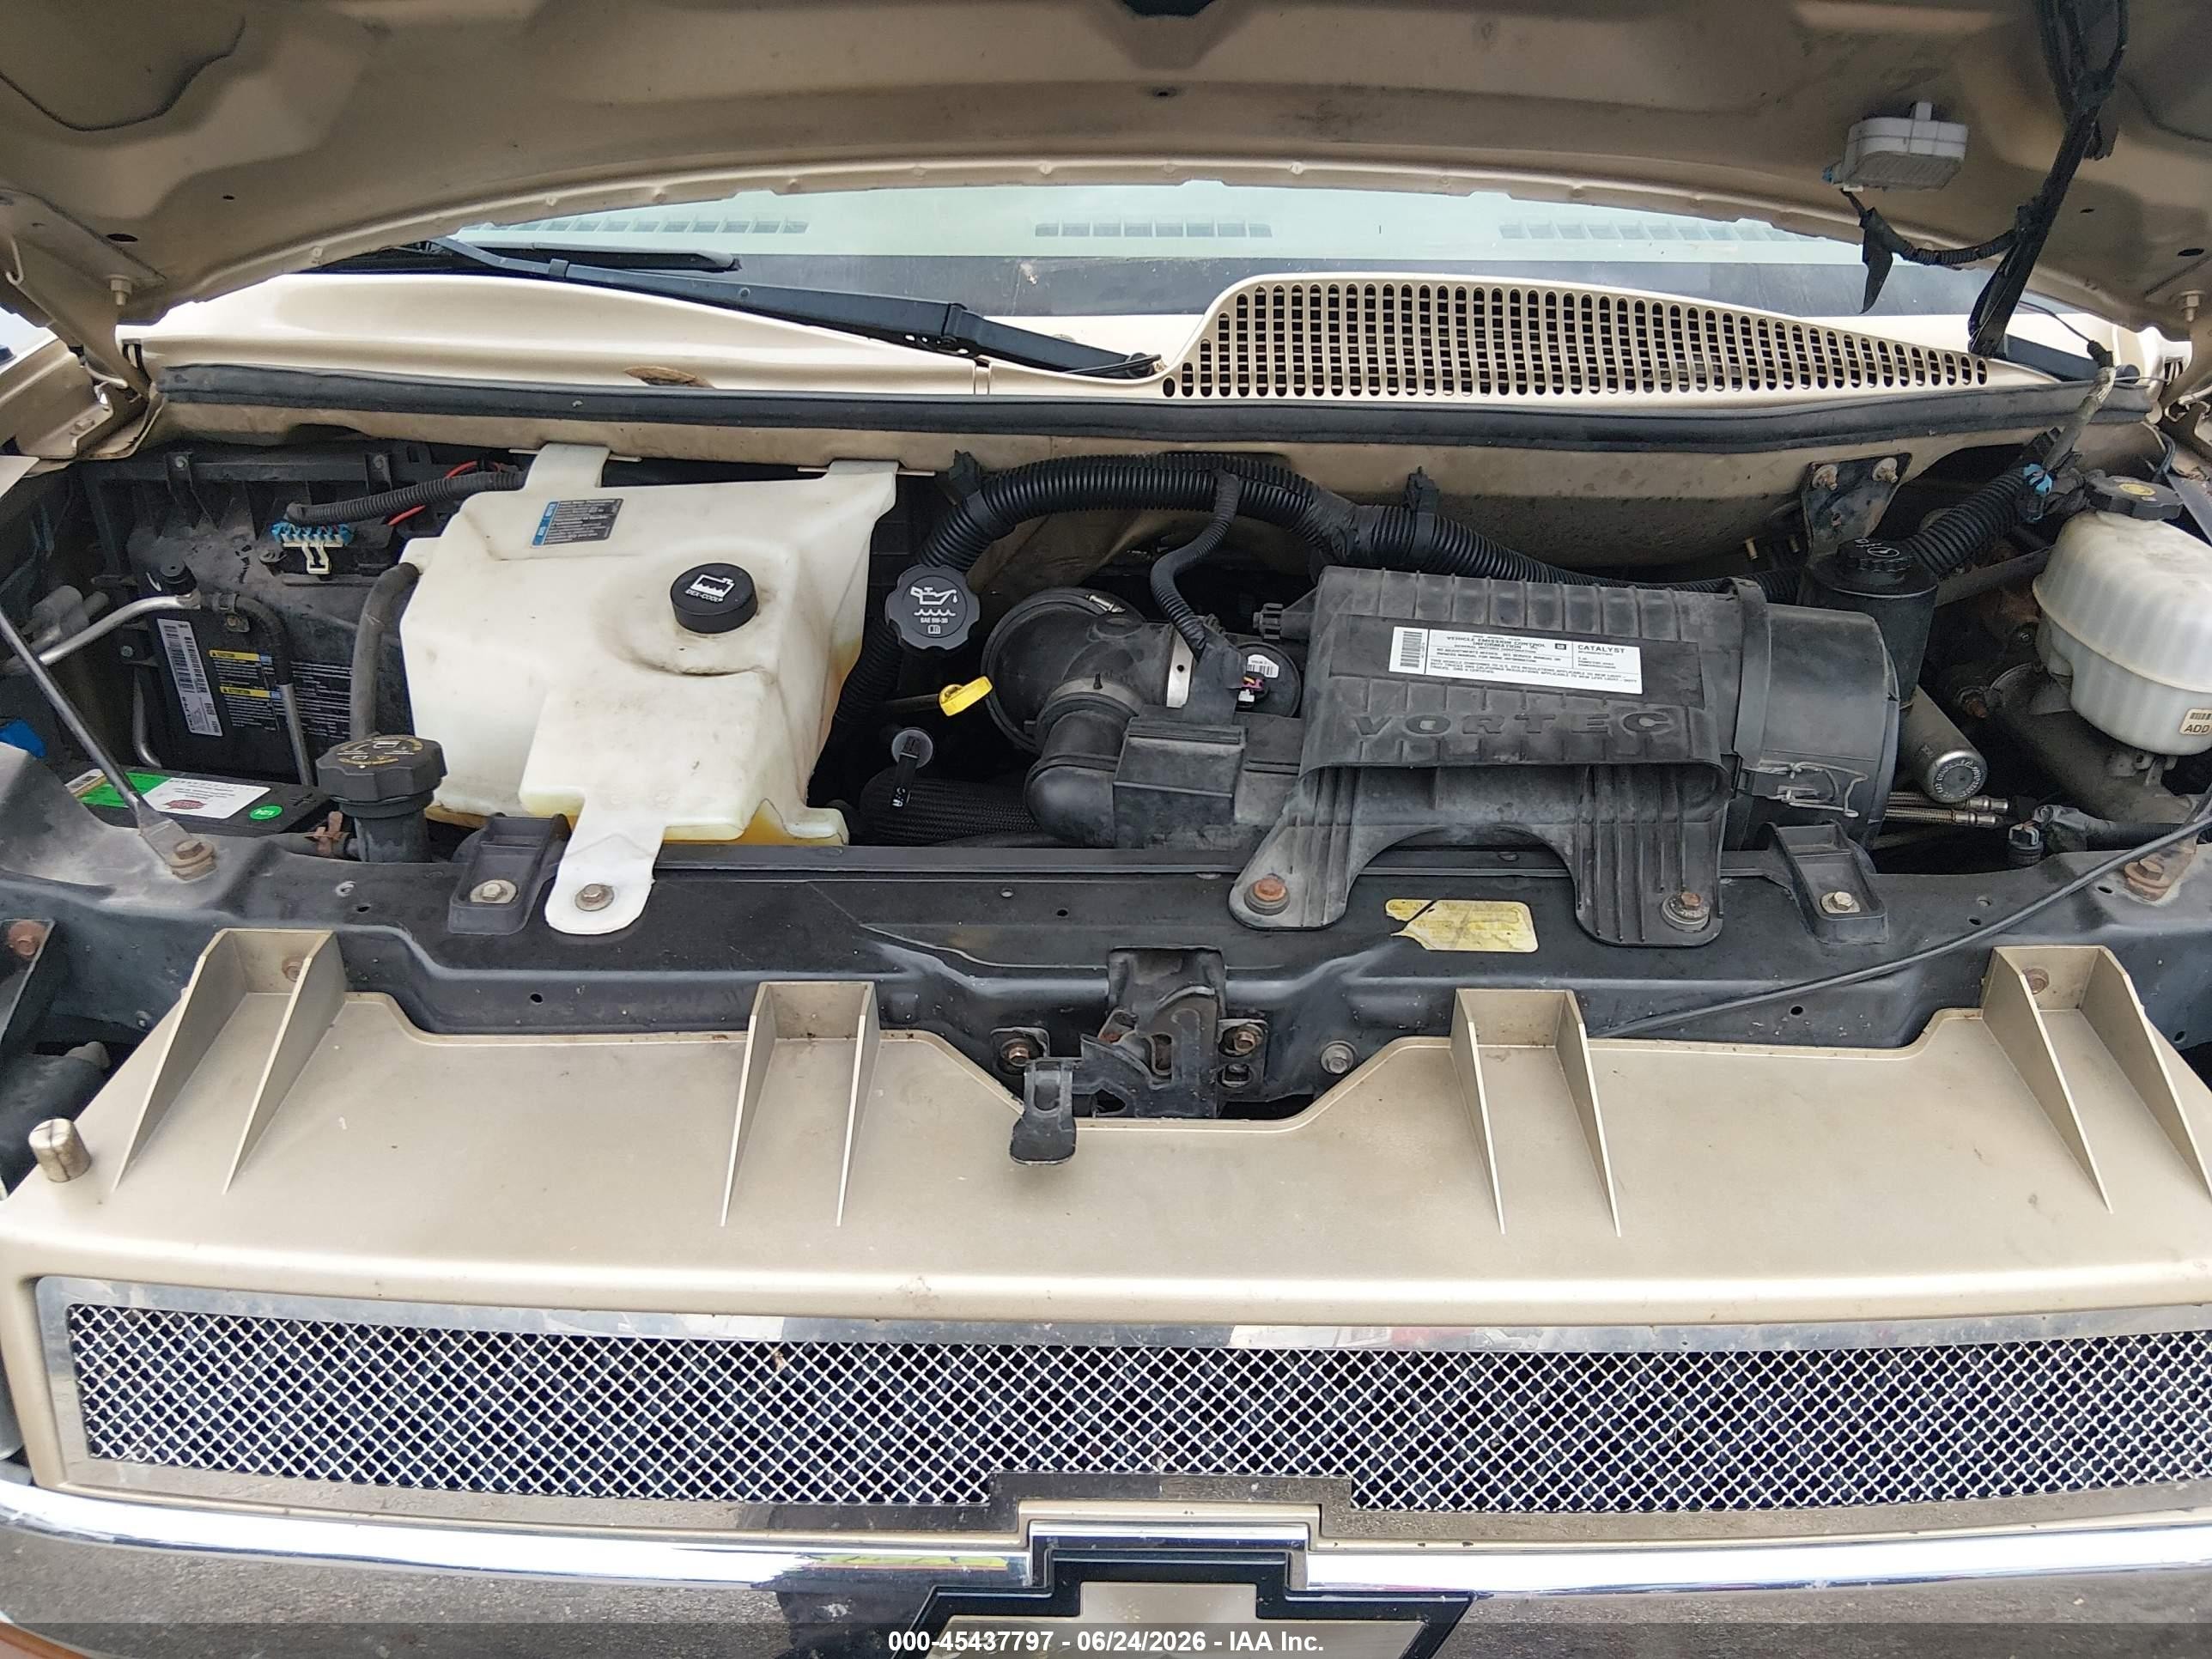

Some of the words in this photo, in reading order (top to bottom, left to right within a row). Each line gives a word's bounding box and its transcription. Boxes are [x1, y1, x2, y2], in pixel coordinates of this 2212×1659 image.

[1578, 645, 1625, 653] CATALYST
[1351, 713, 1674, 737] VORTEC
[2184, 724, 2210, 733] ADD
